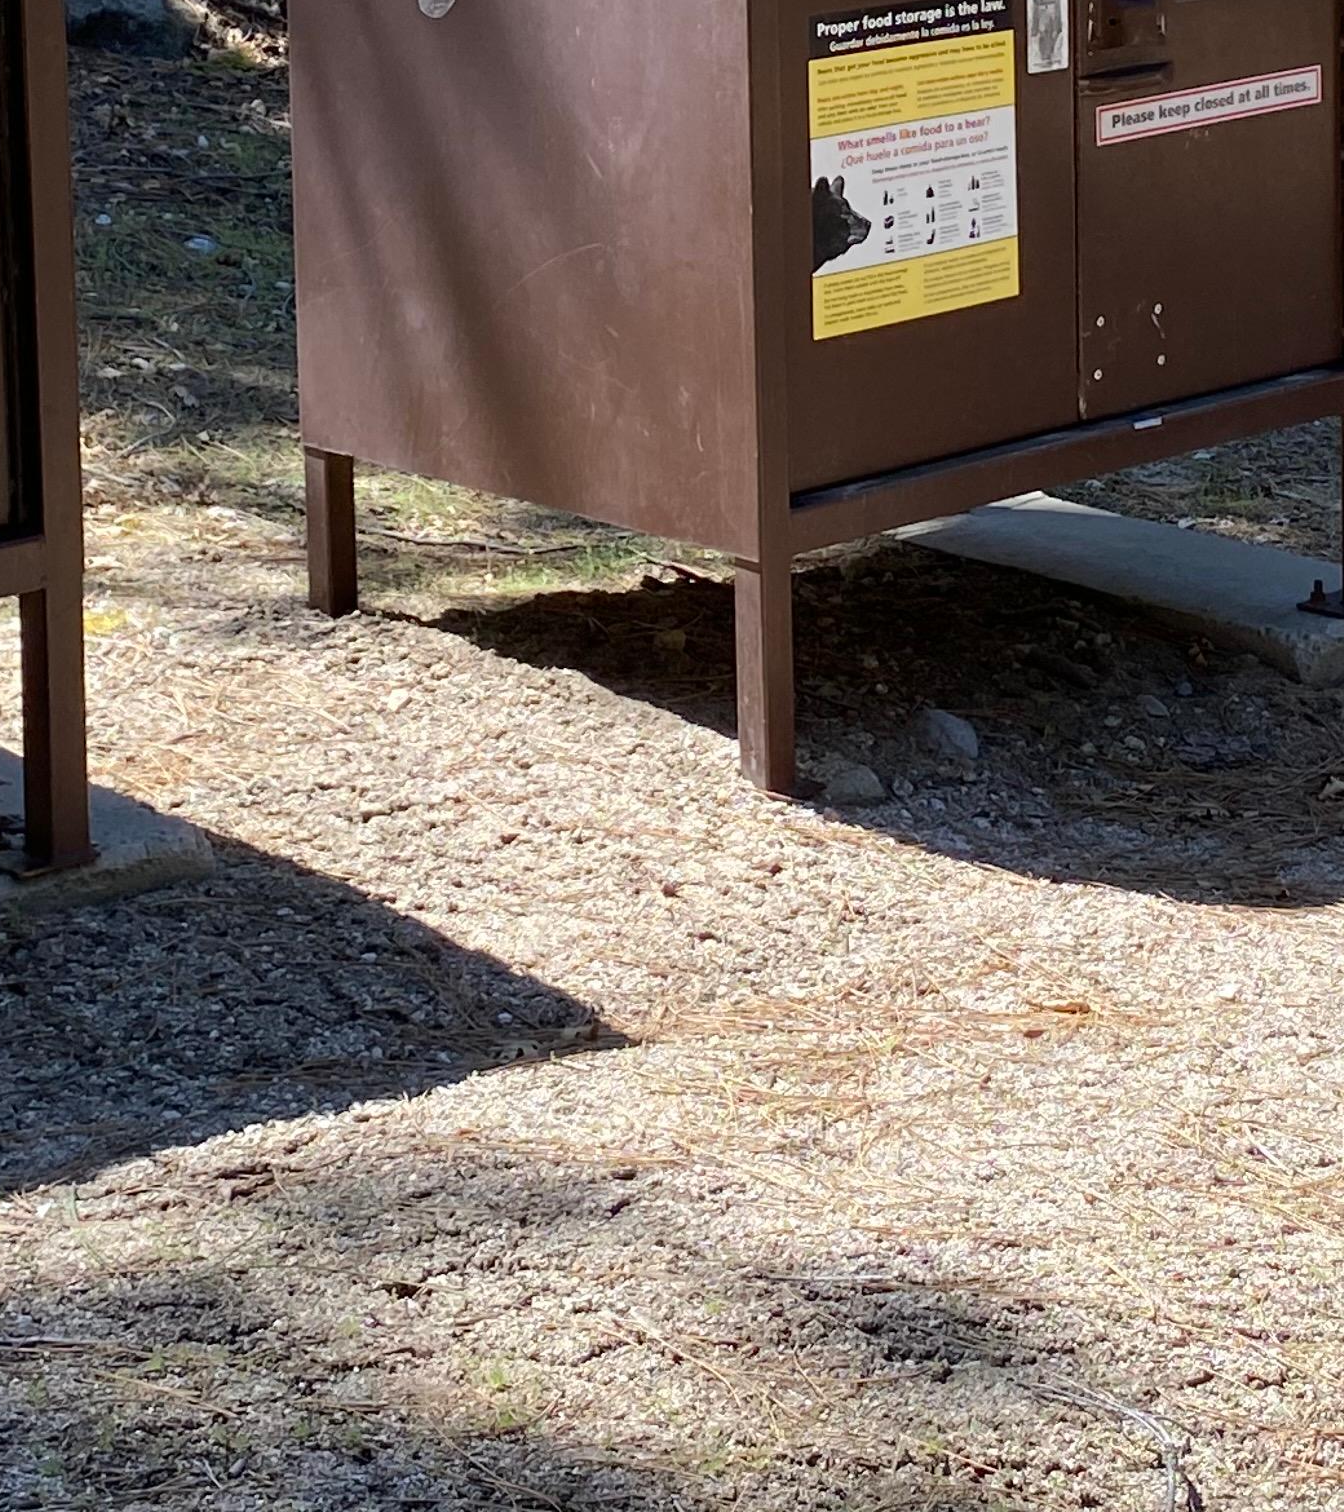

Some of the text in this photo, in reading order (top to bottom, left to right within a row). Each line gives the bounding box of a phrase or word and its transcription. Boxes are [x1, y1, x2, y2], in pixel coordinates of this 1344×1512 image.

[816, 20, 860, 37] Proper
[862, 12, 893, 29] food
[894, 7, 942, 25] storage
[945, 3, 956, 18] is
[957, 1, 978, 16] the
[1112, 79, 1310, 128] Please keep closed at all times.
[837, 116, 992, 152] What smells like food to a bear?
